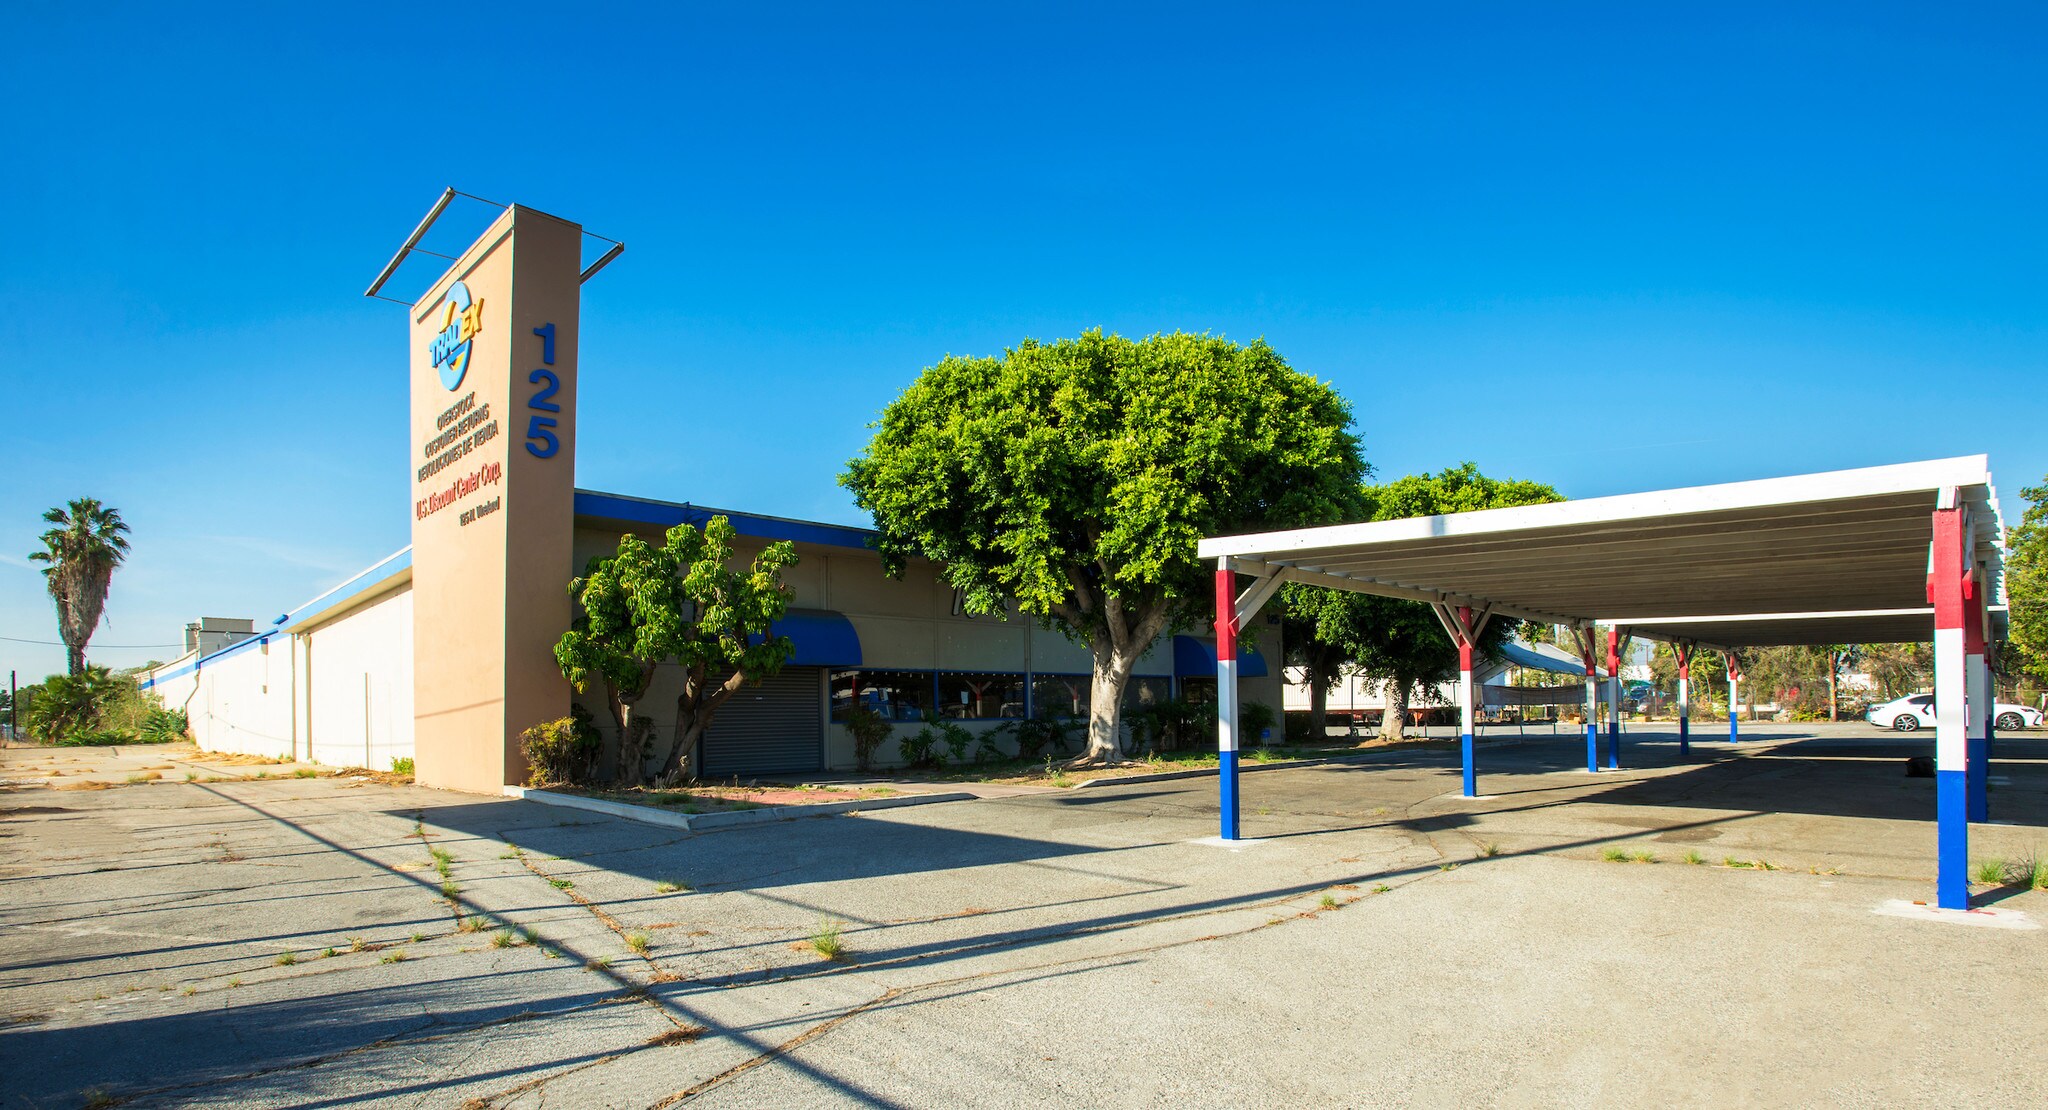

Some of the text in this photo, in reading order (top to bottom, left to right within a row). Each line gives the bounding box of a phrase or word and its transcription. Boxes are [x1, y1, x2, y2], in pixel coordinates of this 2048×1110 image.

[429, 298, 484, 368] TRADEX
[437, 391, 475, 431] OVERSTOCK
[525, 322, 560, 458] 125
[418, 419, 499, 483] DEVOLUCIONES DE TIENDA
[425, 403, 490, 458] CUSTOMER RETURNS
[416, 461, 502, 521] U.S. Discount Center Corp.
